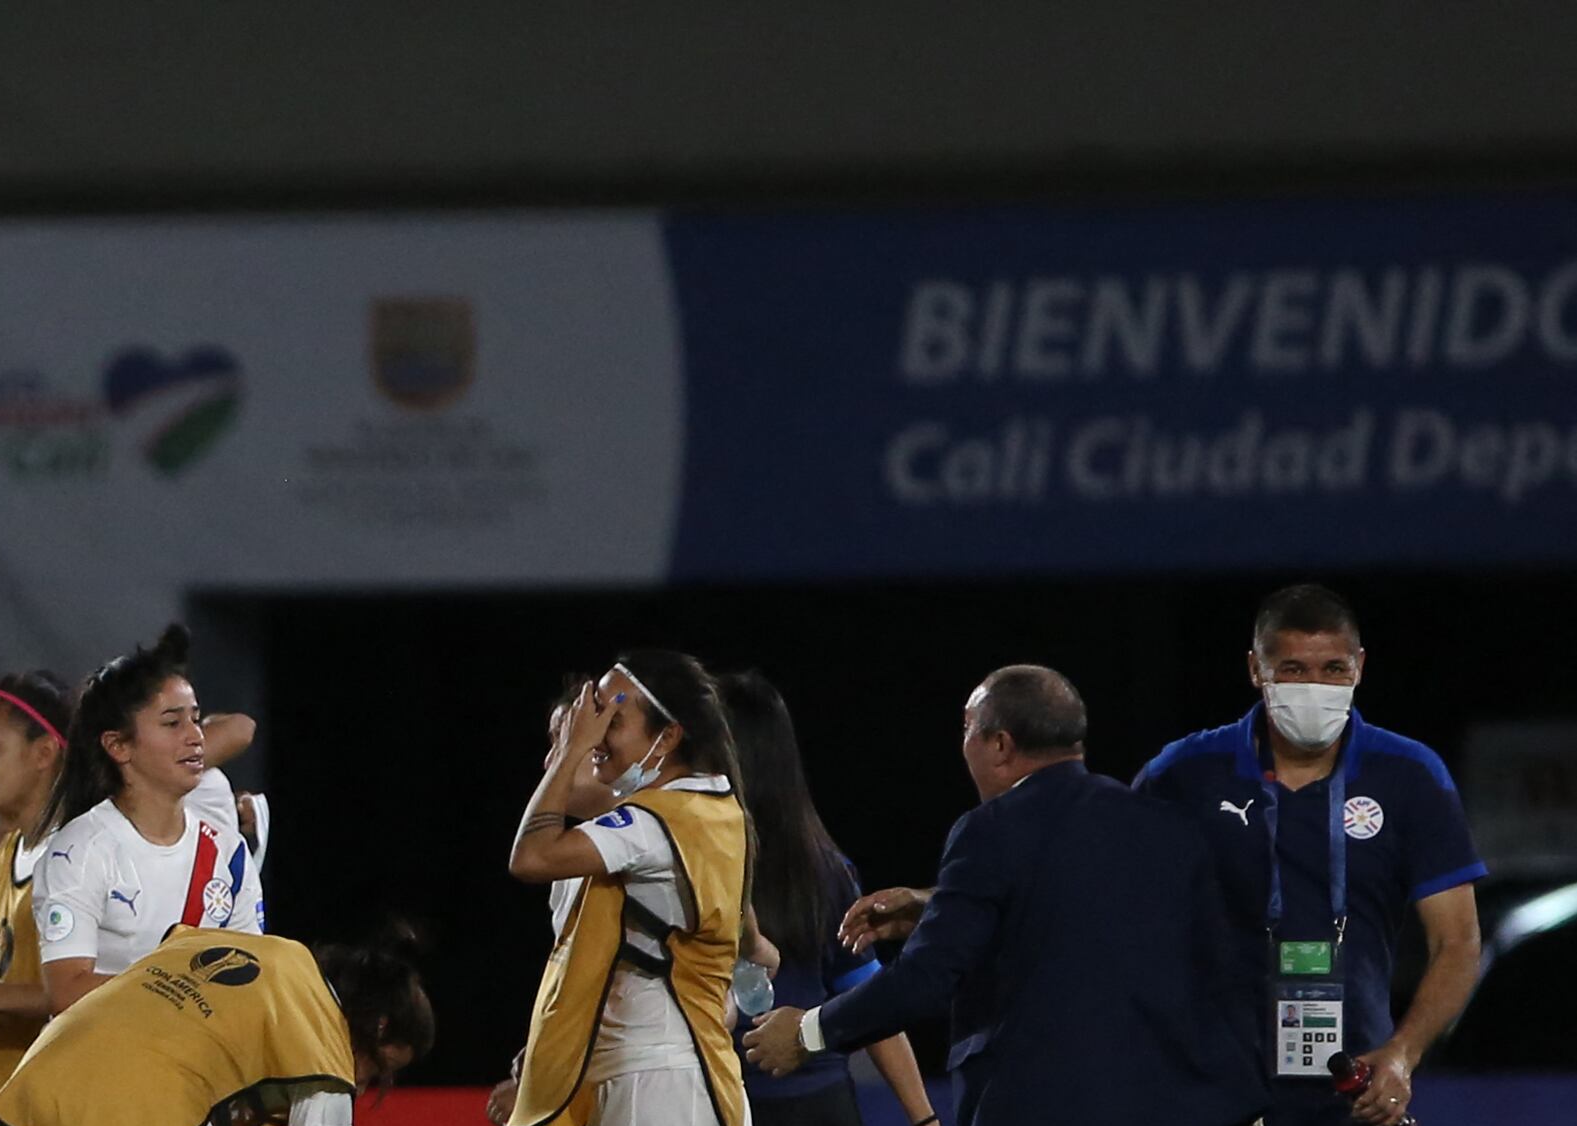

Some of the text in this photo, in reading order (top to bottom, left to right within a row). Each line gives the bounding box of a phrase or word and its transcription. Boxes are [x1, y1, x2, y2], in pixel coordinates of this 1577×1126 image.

[884, 405, 1577, 505] Cali Ciudad Dep
[145, 967, 174, 982] COPA
[169, 978, 213, 1018] AMERICA
